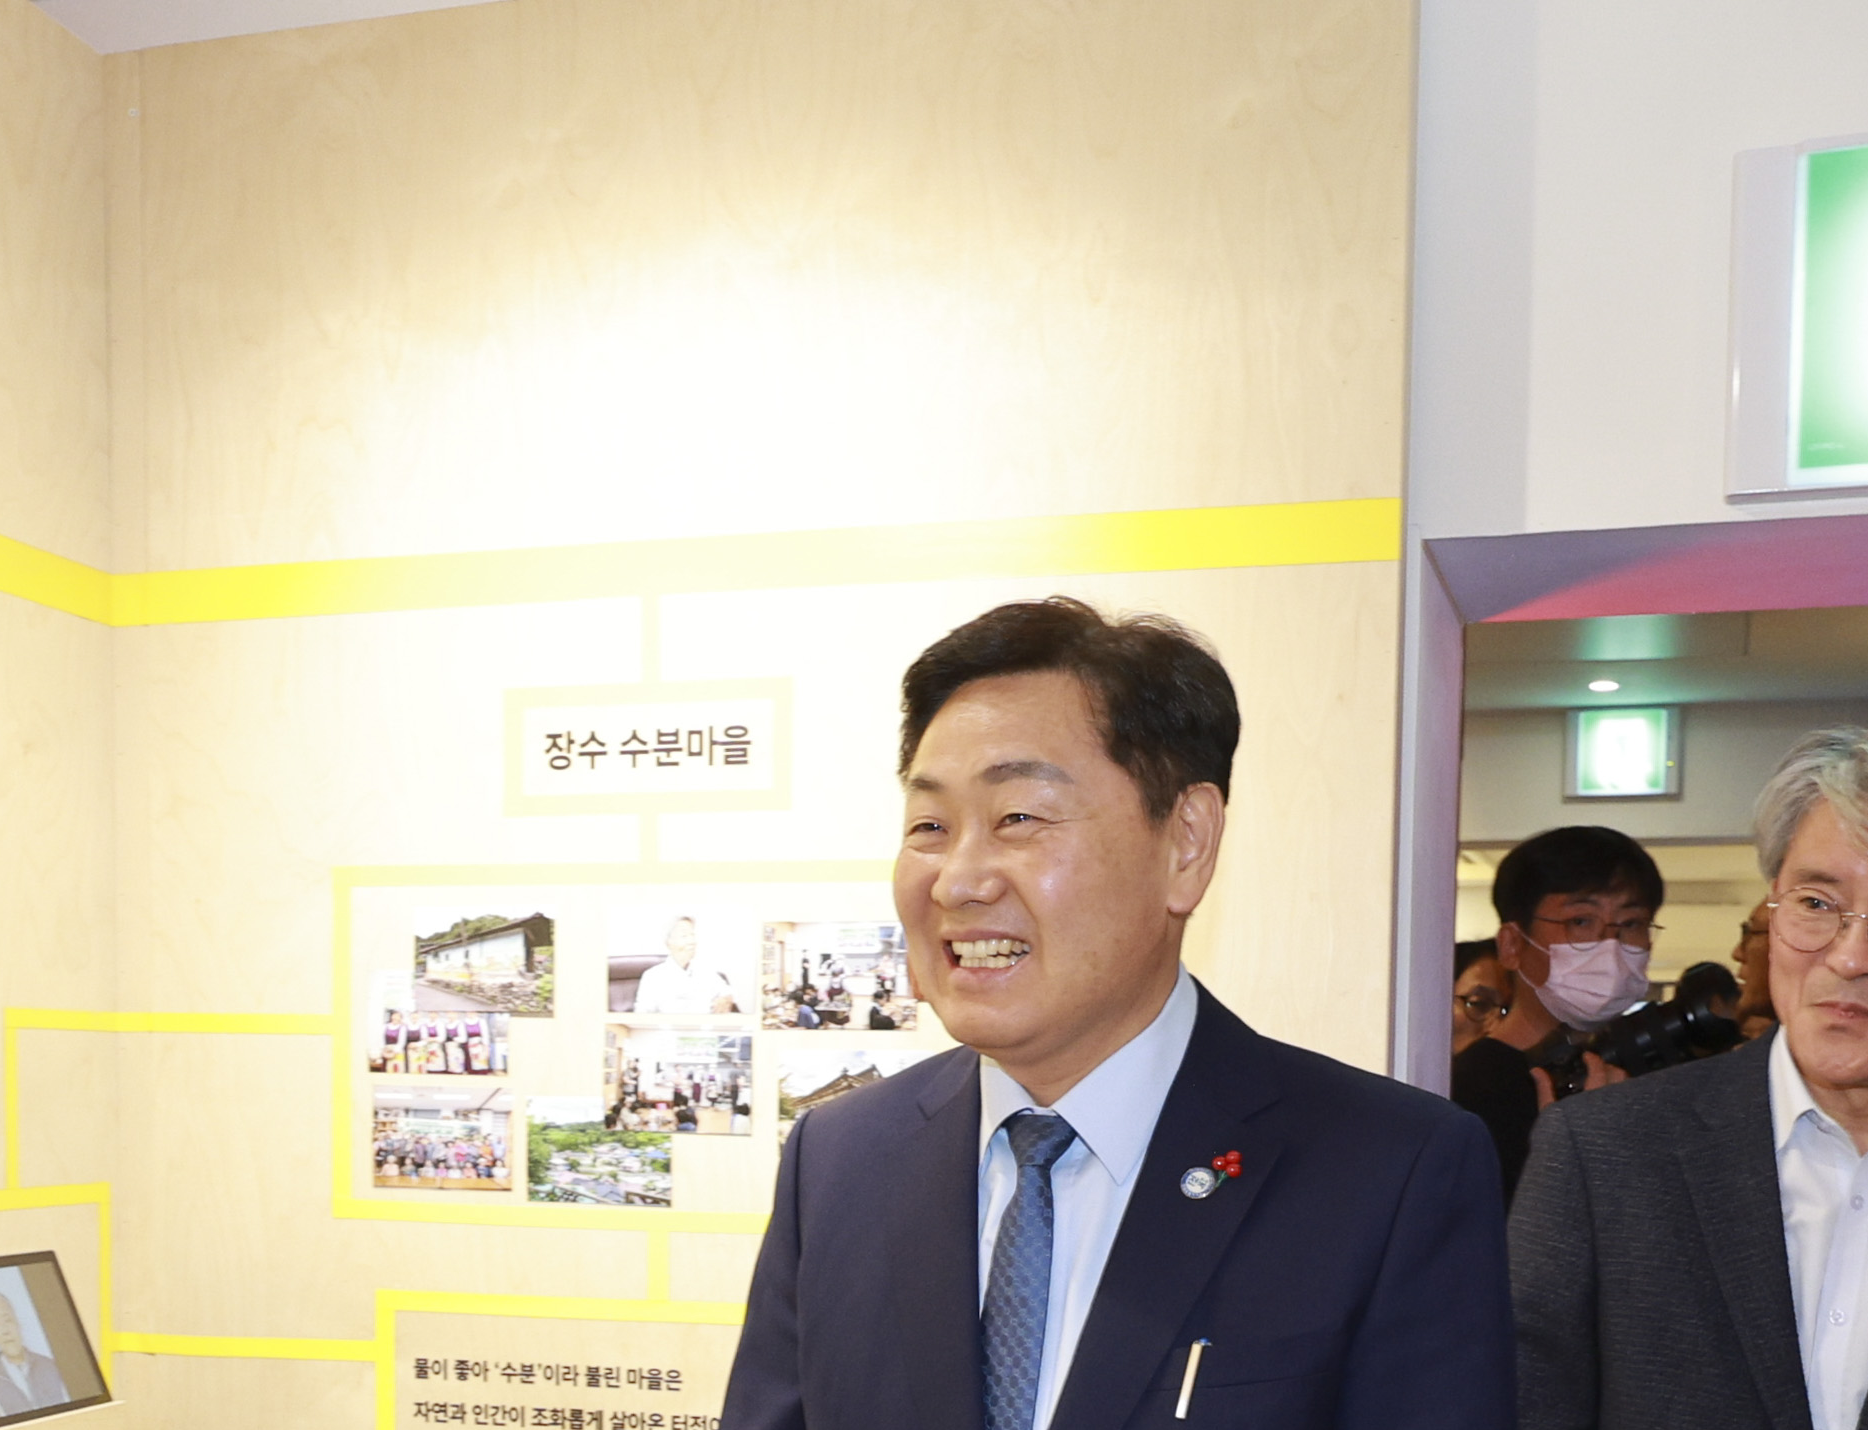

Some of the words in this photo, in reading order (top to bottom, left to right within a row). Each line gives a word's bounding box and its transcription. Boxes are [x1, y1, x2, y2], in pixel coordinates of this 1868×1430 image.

[545, 731, 608, 770] 장수
[619, 725, 752, 769] 수분마을
[413, 1358, 448, 1380] 물이
[454, 1360, 488, 1382] 좋아
[586, 1366, 620, 1388] 불린
[627, 1368, 683, 1391] 마을은
[414, 1401, 466, 1424] 자연과
[472, 1404, 525, 1427] 인간이
[532, 1407, 603, 1430] 조화롭게
